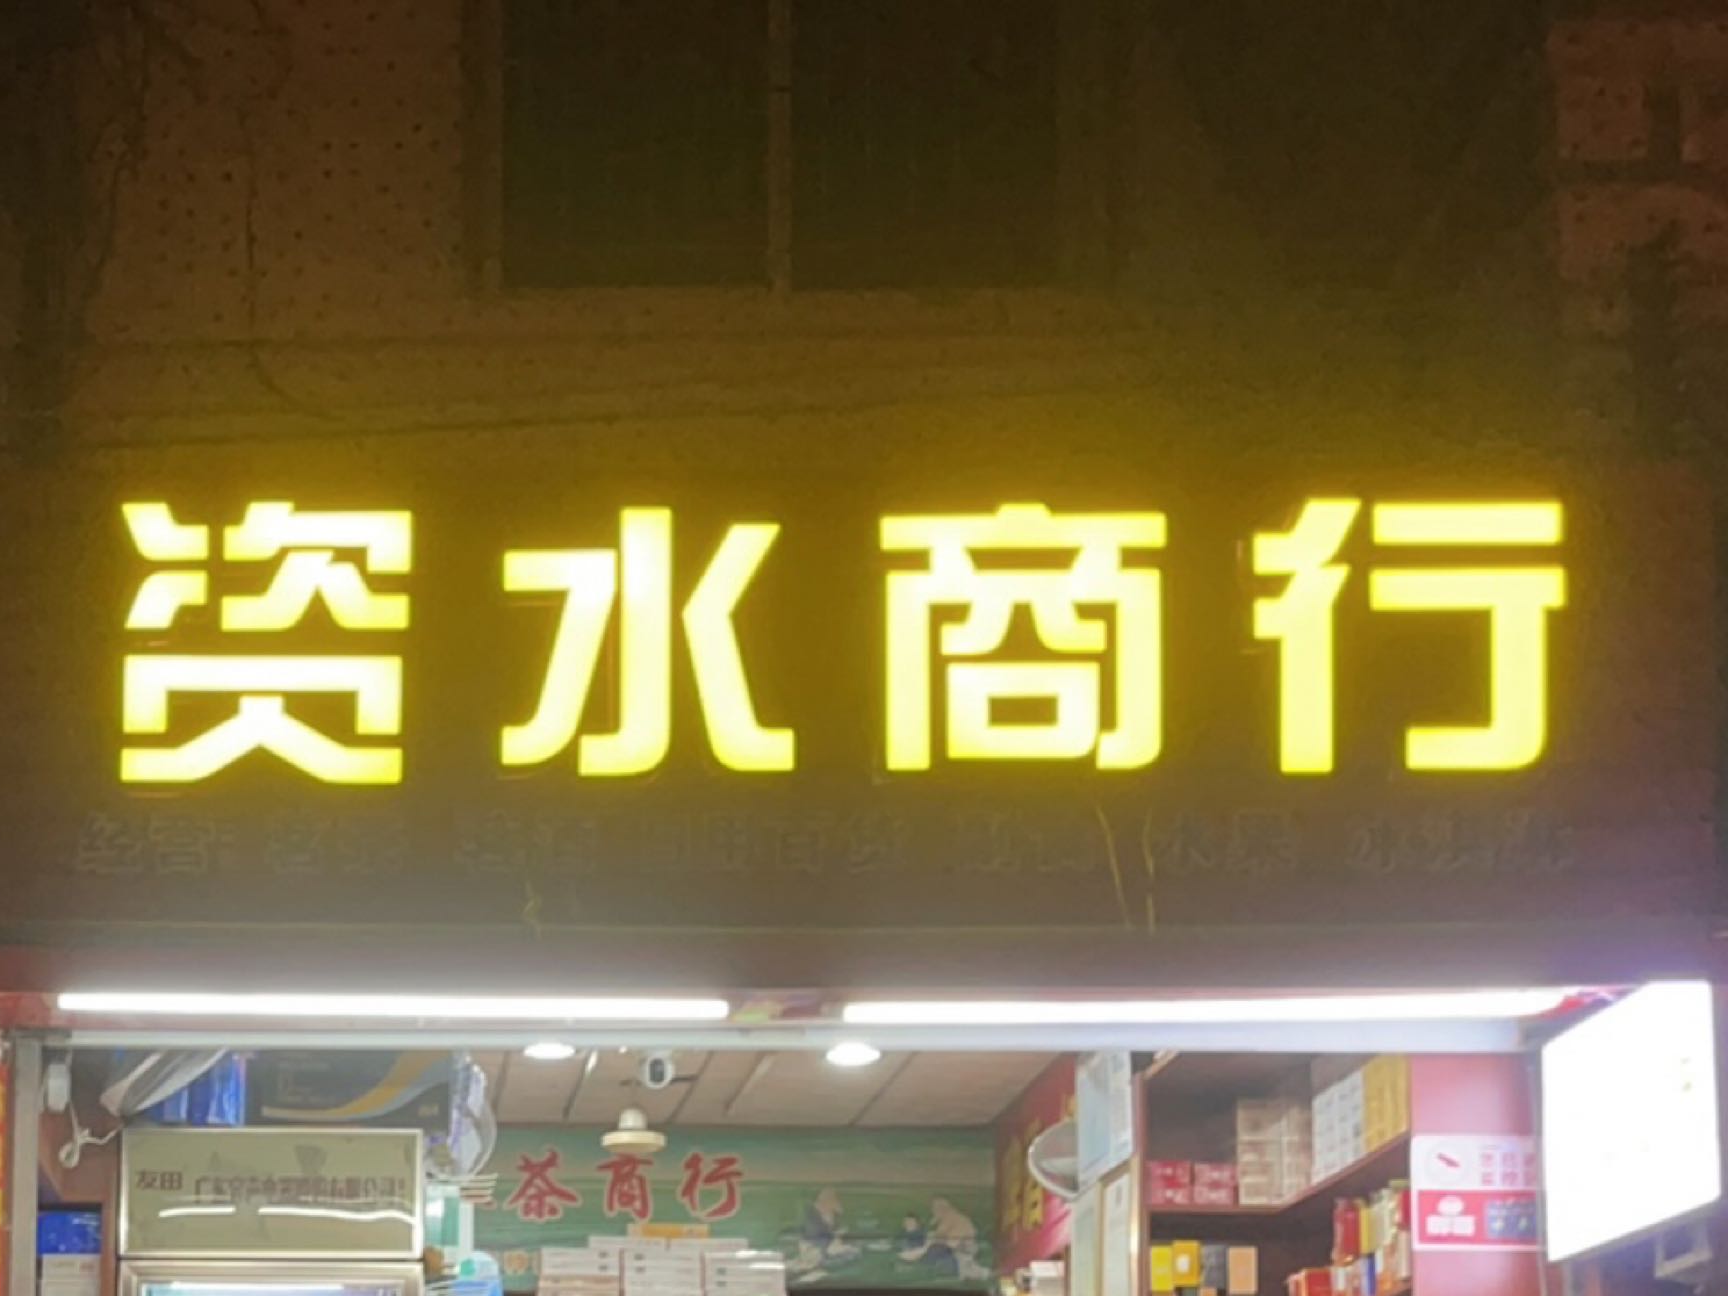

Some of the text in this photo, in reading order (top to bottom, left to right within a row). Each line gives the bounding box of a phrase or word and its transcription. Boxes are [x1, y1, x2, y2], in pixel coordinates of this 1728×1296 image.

[120, 499, 1566, 785] 资水商行
[506, 1147, 746, 1221] 茶商行
